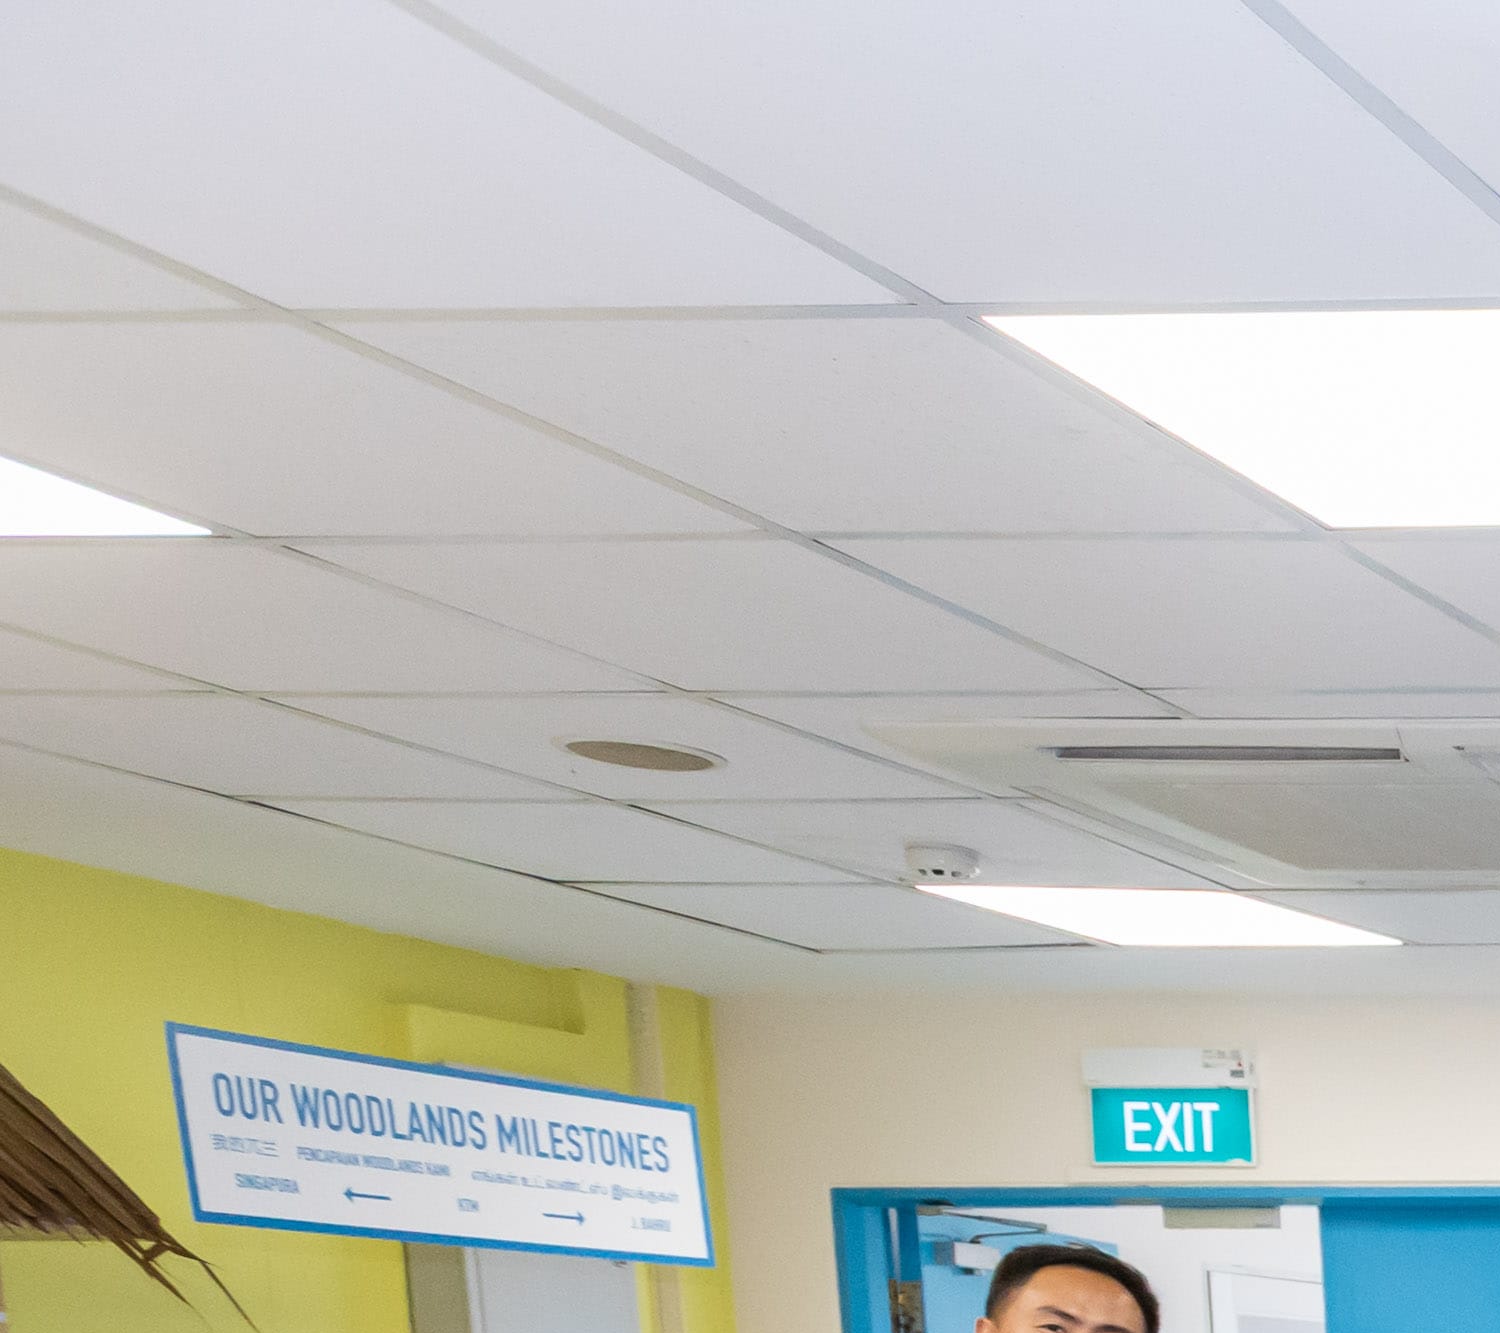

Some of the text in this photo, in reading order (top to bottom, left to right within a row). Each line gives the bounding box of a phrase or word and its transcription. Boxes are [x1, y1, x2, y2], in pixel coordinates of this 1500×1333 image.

[212, 1073, 669, 1173] OUR WOODLANDS MILESTONES
[1123, 1101, 1220, 1152] EXIT
